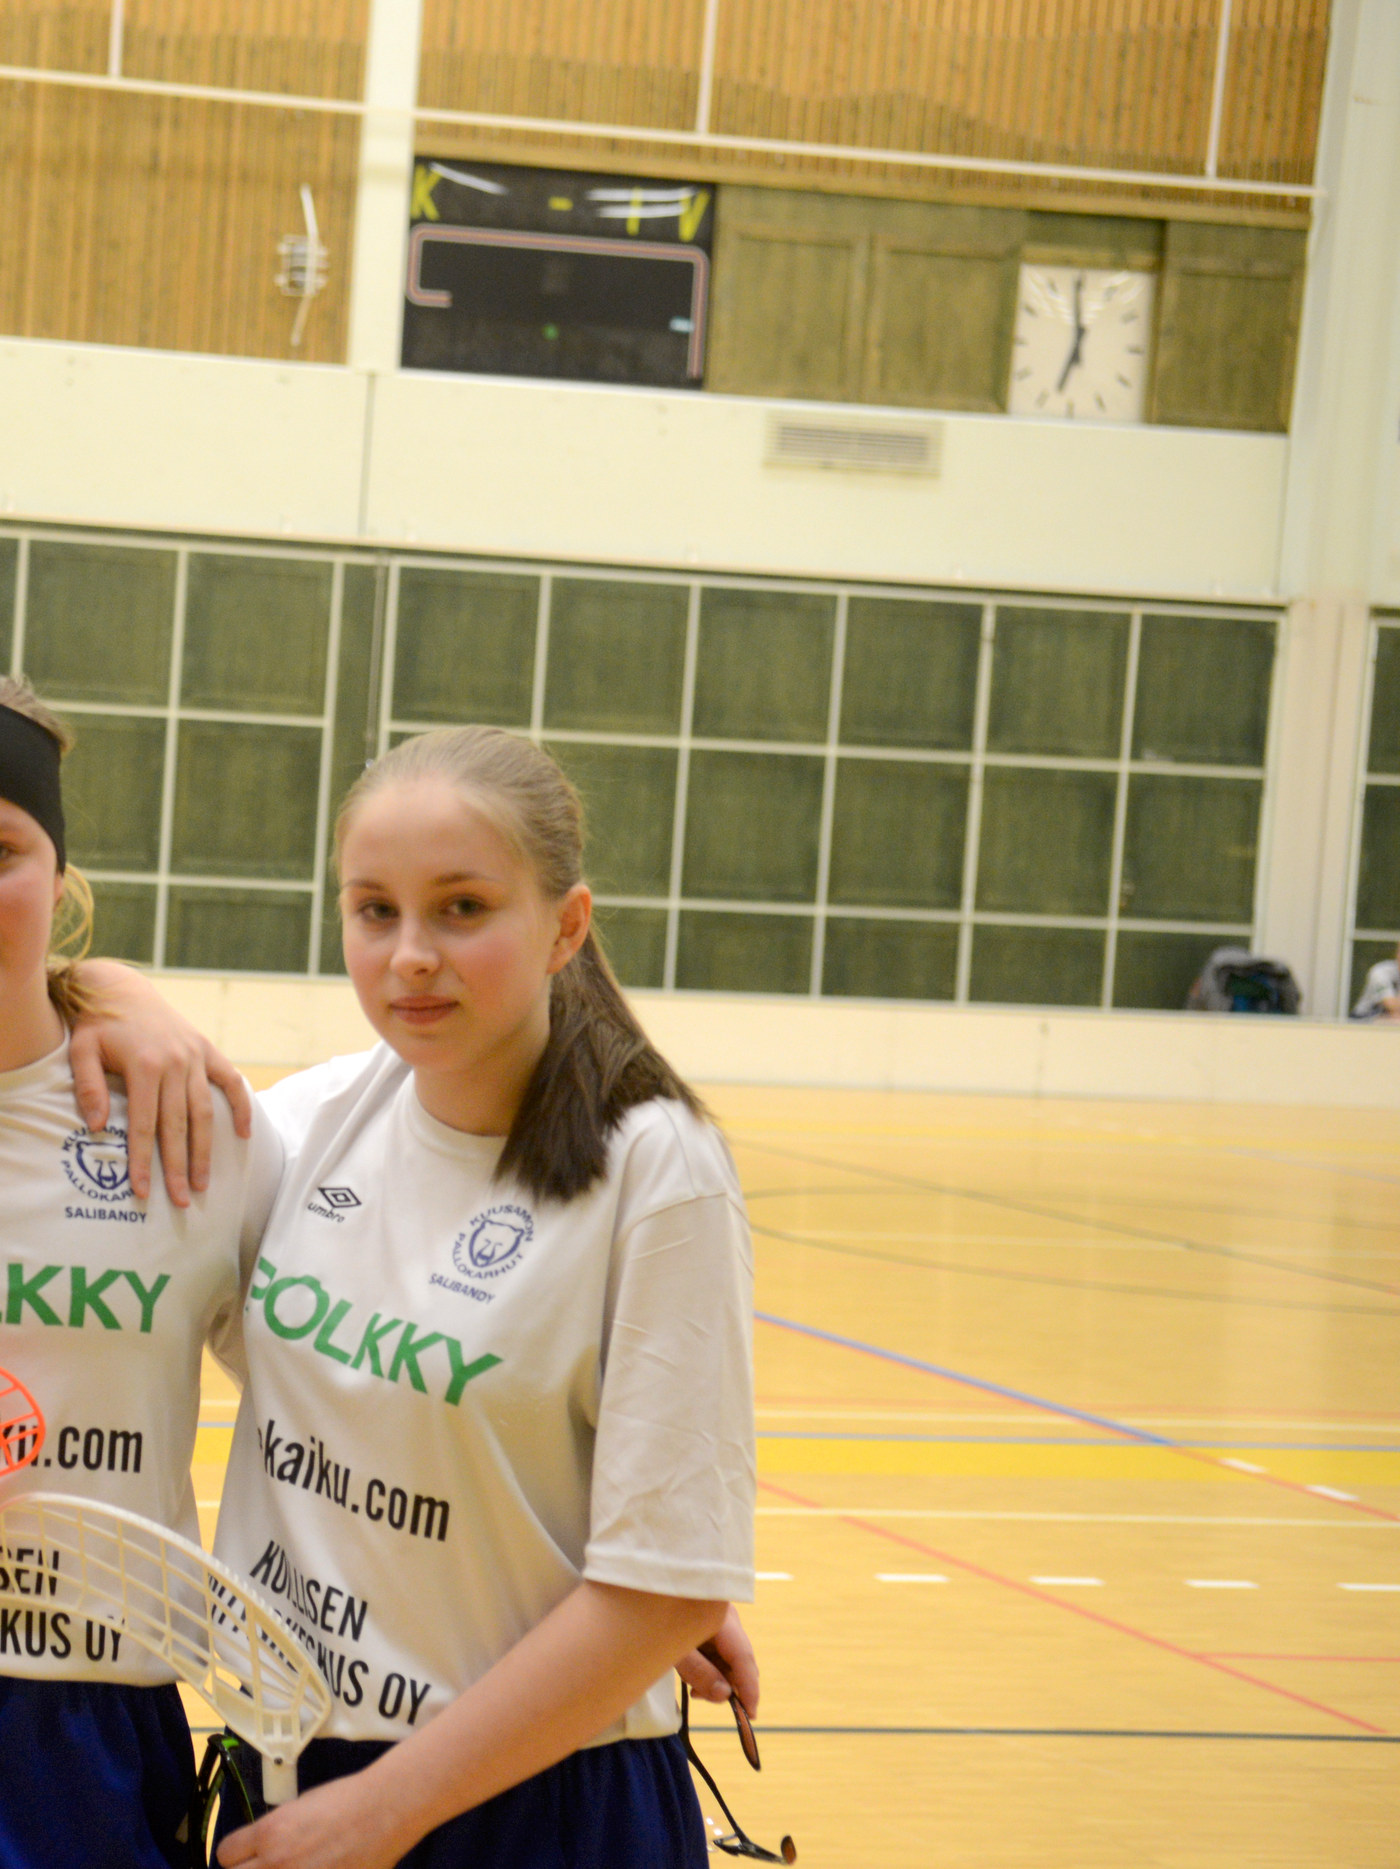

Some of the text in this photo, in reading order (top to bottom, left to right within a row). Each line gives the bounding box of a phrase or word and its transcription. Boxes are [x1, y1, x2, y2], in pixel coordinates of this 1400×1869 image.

[65, 1206, 148, 1224] SALIBANDY
[307, 1202, 346, 1224] umbro
[428, 1273, 496, 1303] SALIBANDY
[378, 1672, 432, 1727] OY
